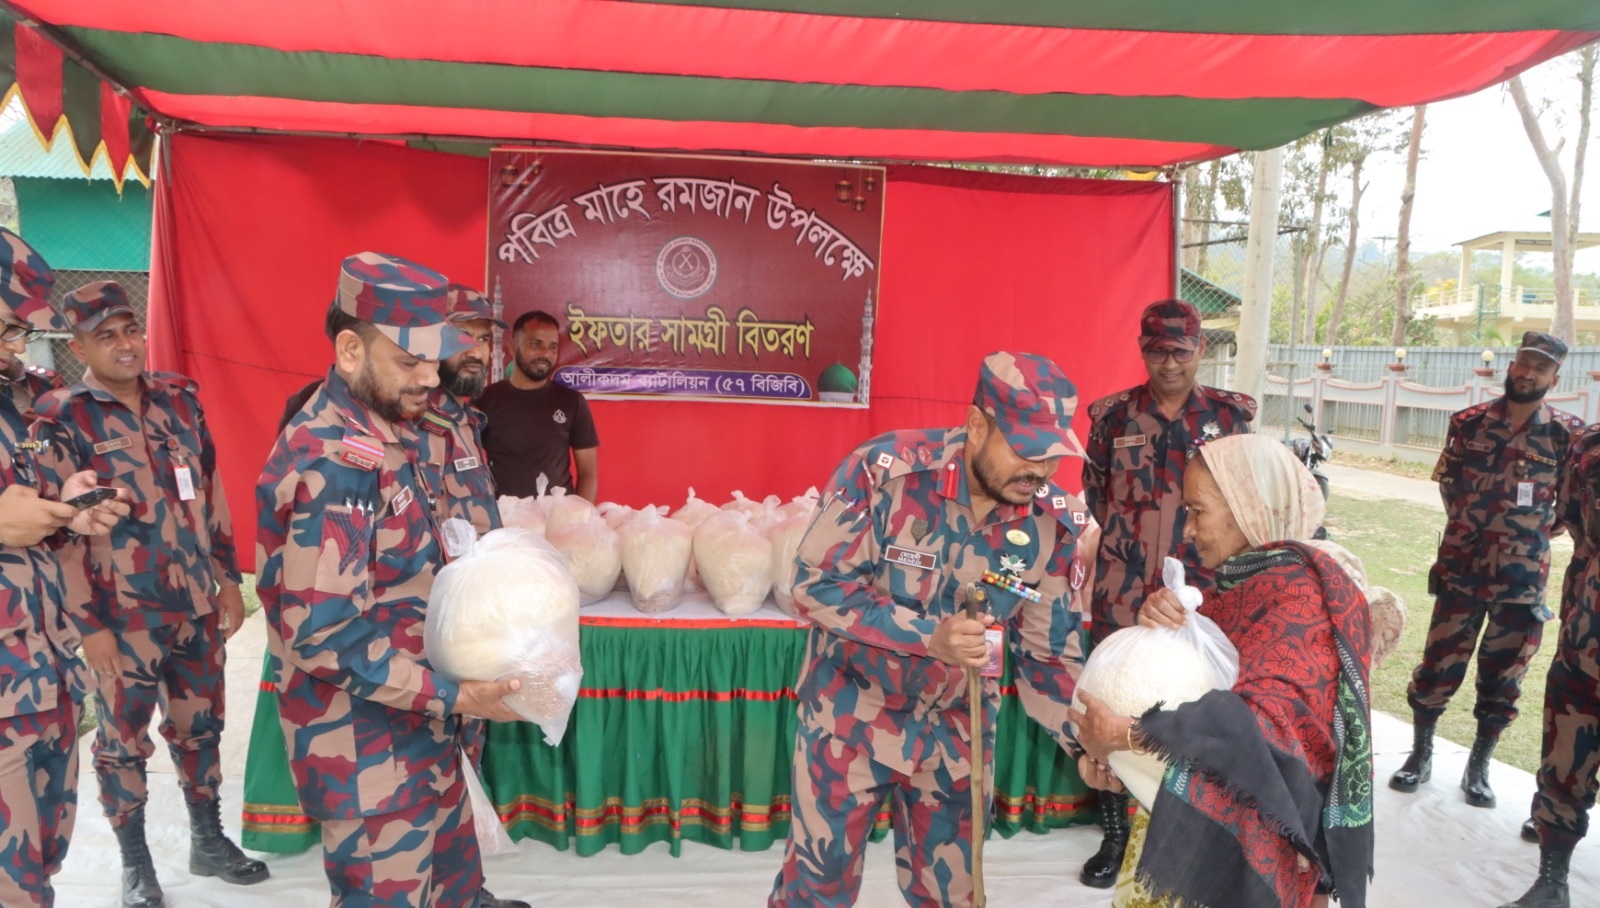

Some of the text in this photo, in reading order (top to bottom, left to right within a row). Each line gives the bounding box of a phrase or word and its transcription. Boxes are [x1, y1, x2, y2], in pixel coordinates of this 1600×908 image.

[499, 178, 874, 281] পবিত্র মাহে রমজান উপলক্ষে
[568, 304, 814, 359] ইফতার সামগ্রী বিতরণ
[560, 369, 806, 396] আলীকদম ব্যাটালিয়ন (৫৭ বিজিবি)
